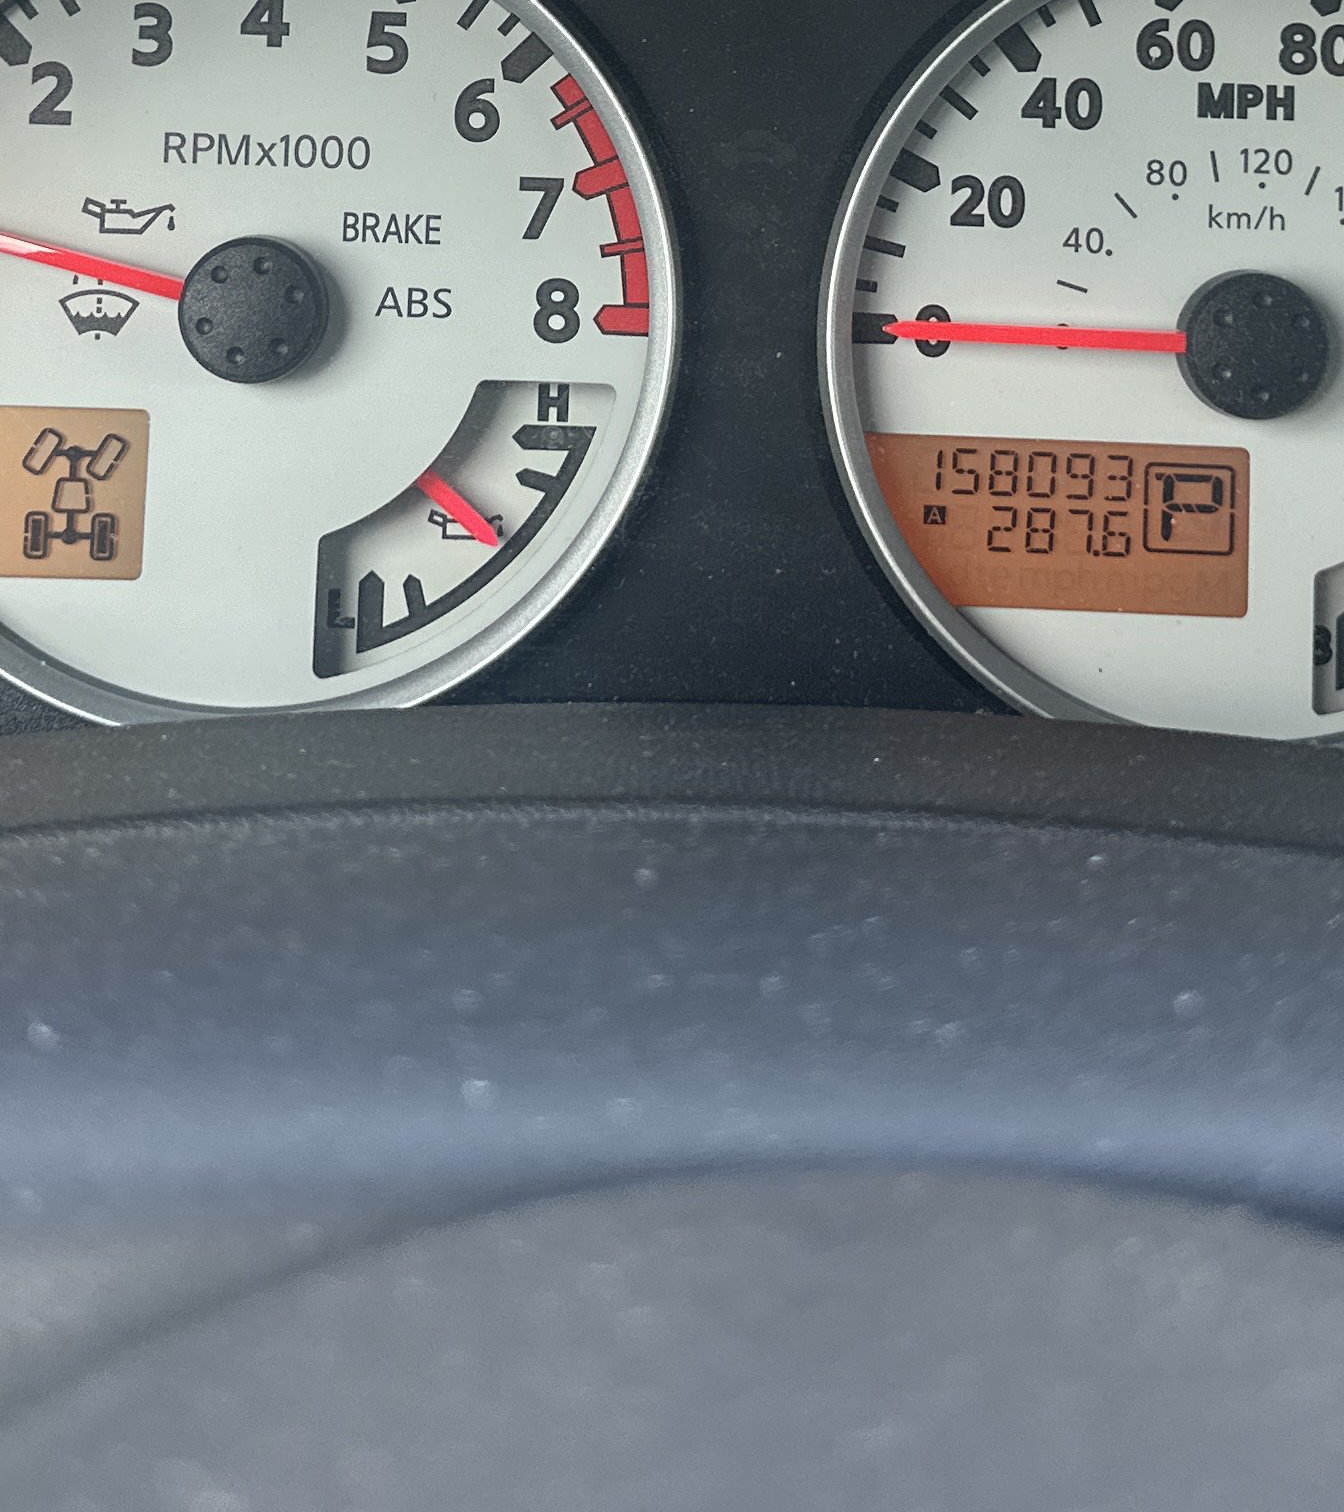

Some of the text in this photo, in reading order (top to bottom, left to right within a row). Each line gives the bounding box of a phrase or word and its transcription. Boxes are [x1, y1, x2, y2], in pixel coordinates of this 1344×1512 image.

[131, 3, 174, 65] 3
[366, 12, 409, 73] 5
[1135, 19, 1215, 71] 60
[28, 64, 73, 124] 2
[454, 79, 499, 142] 6
[1020, 77, 1103, 130] 40
[1197, 83, 1295, 121] MPH
[163, 131, 371, 171] RPMx1000
[1146, 159, 1187, 187] 80
[1241, 149, 1293, 175] 120
[520, 178, 564, 240] 7
[950, 175, 1025, 227] 20
[1208, 204, 1286, 233] km/h
[342, 211, 442, 244] BRAKE
[1063, 227, 1105, 255] 40
[375, 287, 452, 319] ABS
[534, 280, 580, 342] 8
[915, 304, 951, 358] 0
[537, 384, 569, 422] H
[936, 448, 1133, 501] 158093
[924, 505, 1131, 556] A 287.6
[1155, 472, 1222, 541] P
